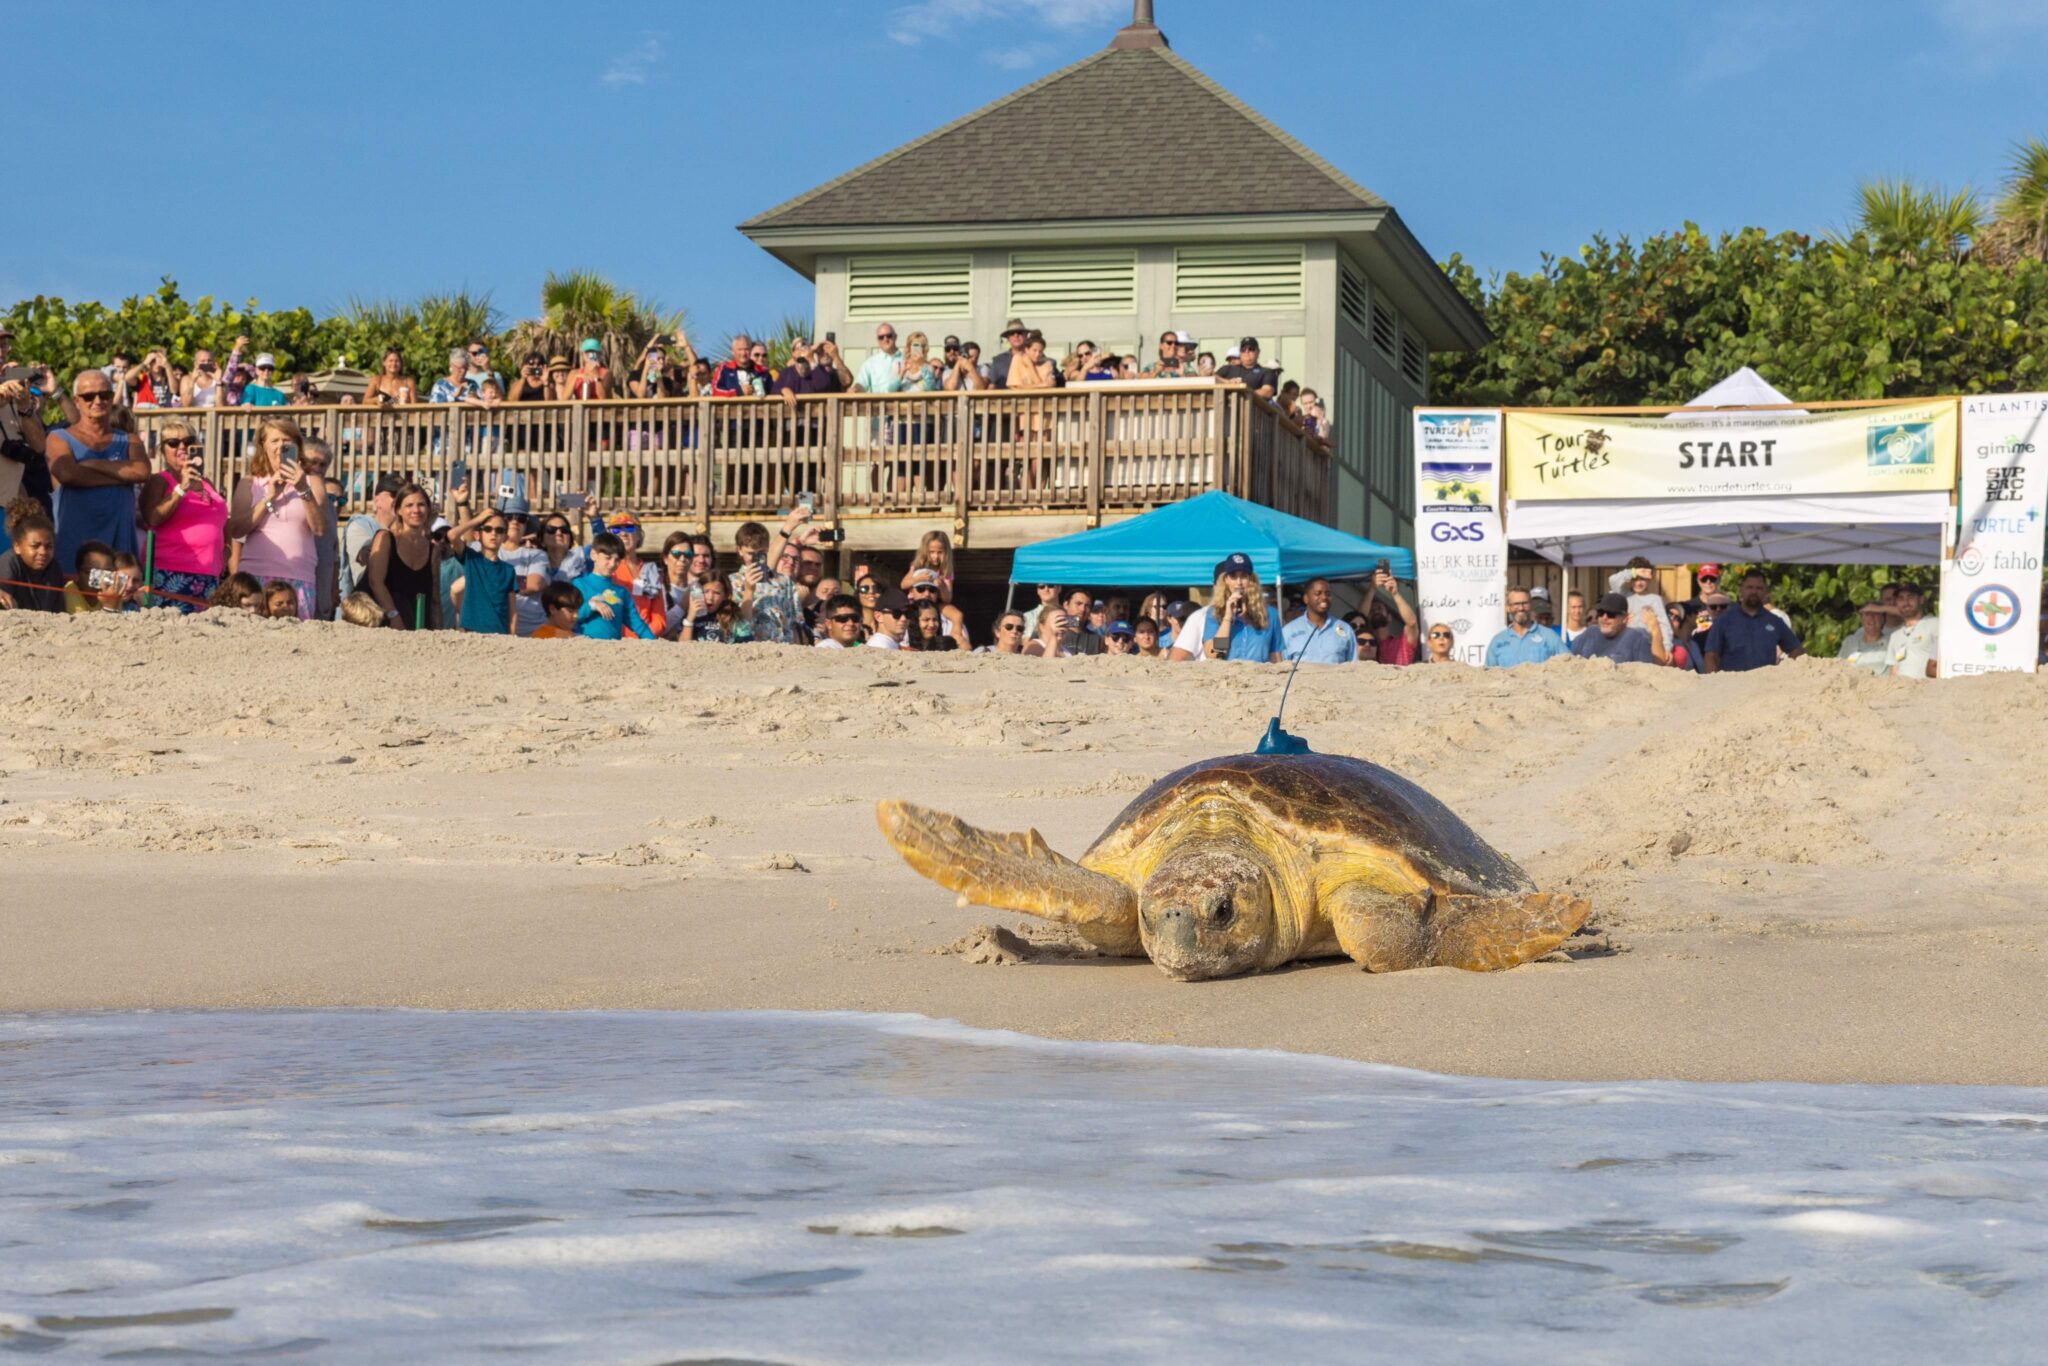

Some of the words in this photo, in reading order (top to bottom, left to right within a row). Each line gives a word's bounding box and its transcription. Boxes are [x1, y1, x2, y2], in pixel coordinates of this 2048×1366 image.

[1968, 399, 2048, 414] ATLANTIS
[1660, 421, 1675, 429] sea
[1676, 420, 1704, 429] turtles
[1781, 417, 1797, 425] not
[1536, 433, 1584, 454] Tour
[1977, 442, 2036, 460] gimme
[1679, 439, 1777, 469] START
[1533, 452, 1611, 485] Turtles
[1986, 466, 2025, 479] SUP
[1667, 480, 1792, 493] www.tourdeturtles.org
[1431, 521, 1484, 542] GxS
[1973, 518, 2025, 534] TURTLE
[1467, 554, 1499, 568] REEF
[1994, 550, 2038, 570] fahlo
[1448, 644, 1485, 663] RAFT
